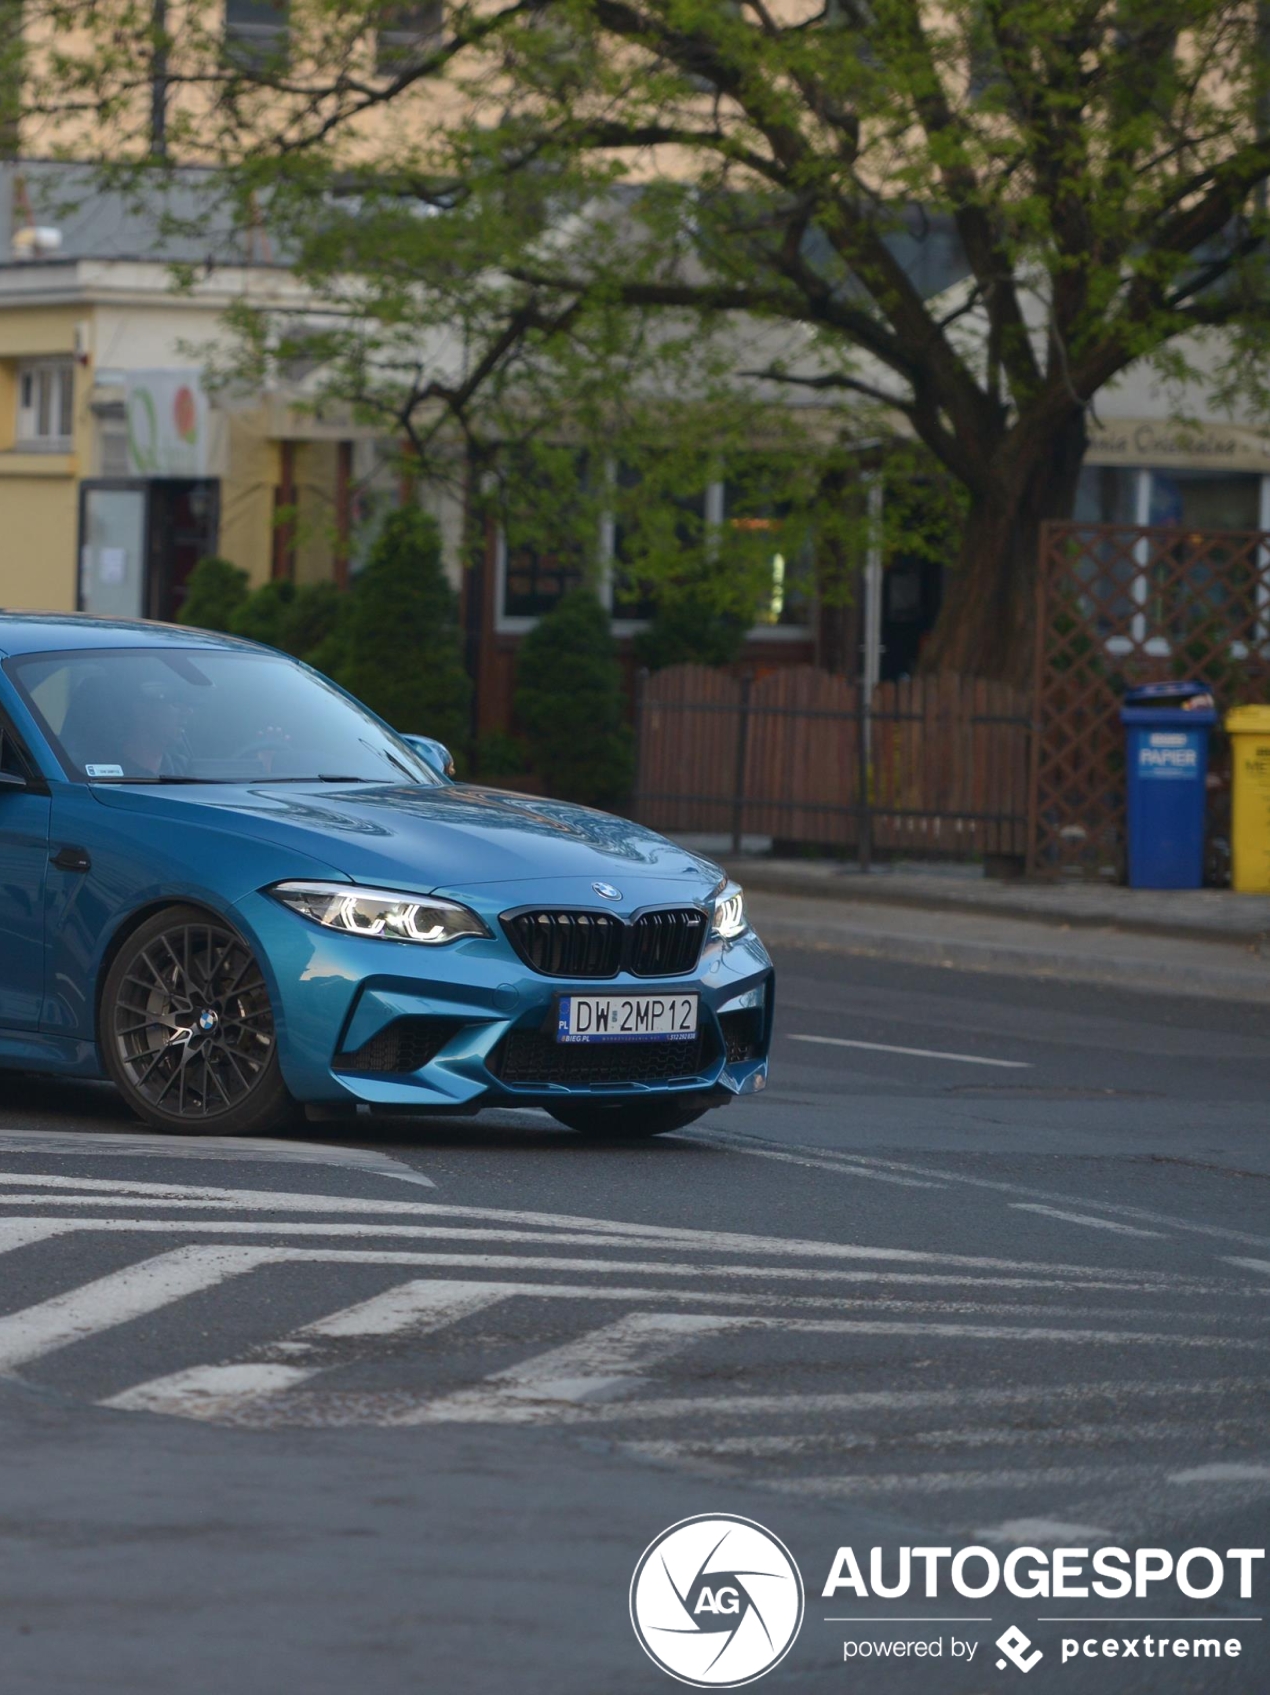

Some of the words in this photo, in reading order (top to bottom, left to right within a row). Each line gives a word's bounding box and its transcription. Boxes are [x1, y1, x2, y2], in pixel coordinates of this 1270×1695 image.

[1139, 748, 1197, 766] PAPIER
[576, 1001, 610, 1032] DW
[620, 999, 692, 1032] 2MP12
[558, 1020, 569, 1030] PL
